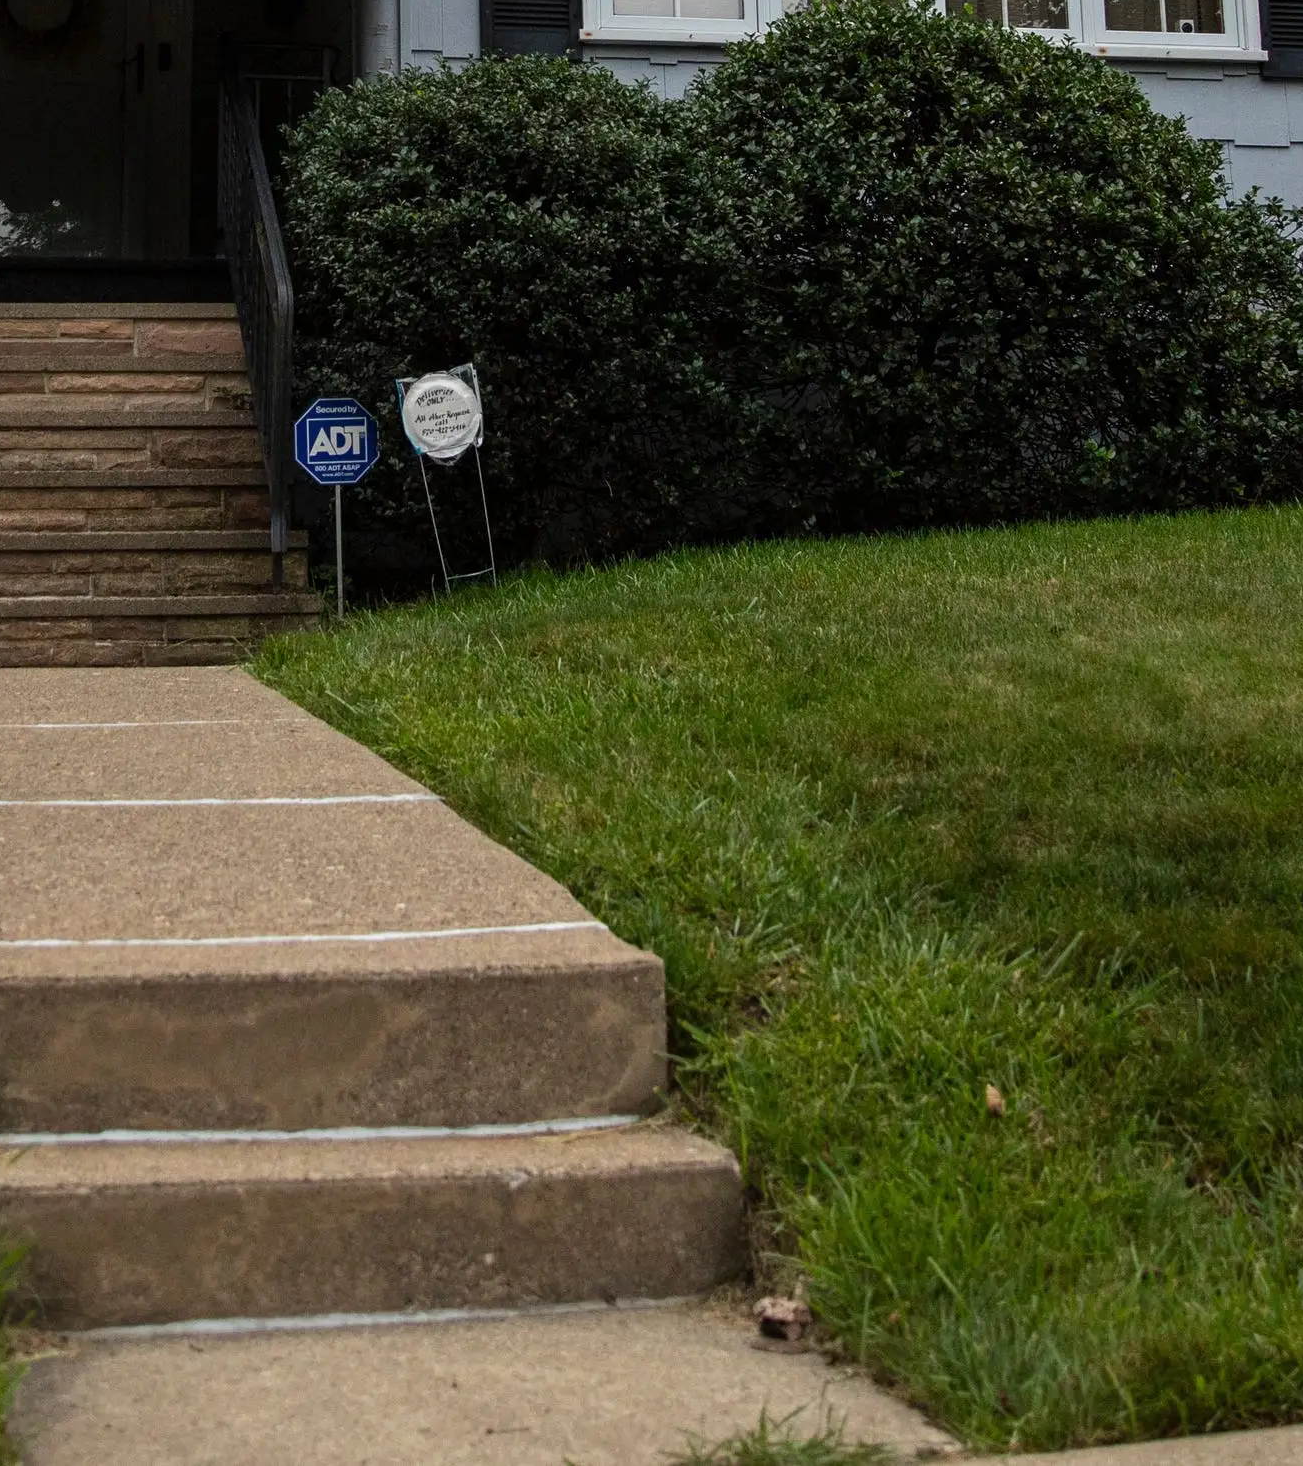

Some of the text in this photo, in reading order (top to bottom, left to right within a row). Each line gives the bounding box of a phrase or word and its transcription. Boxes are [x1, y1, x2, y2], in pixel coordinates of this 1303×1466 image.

[316, 405, 357, 414] Secured by
[309, 425, 366, 456] ADT
